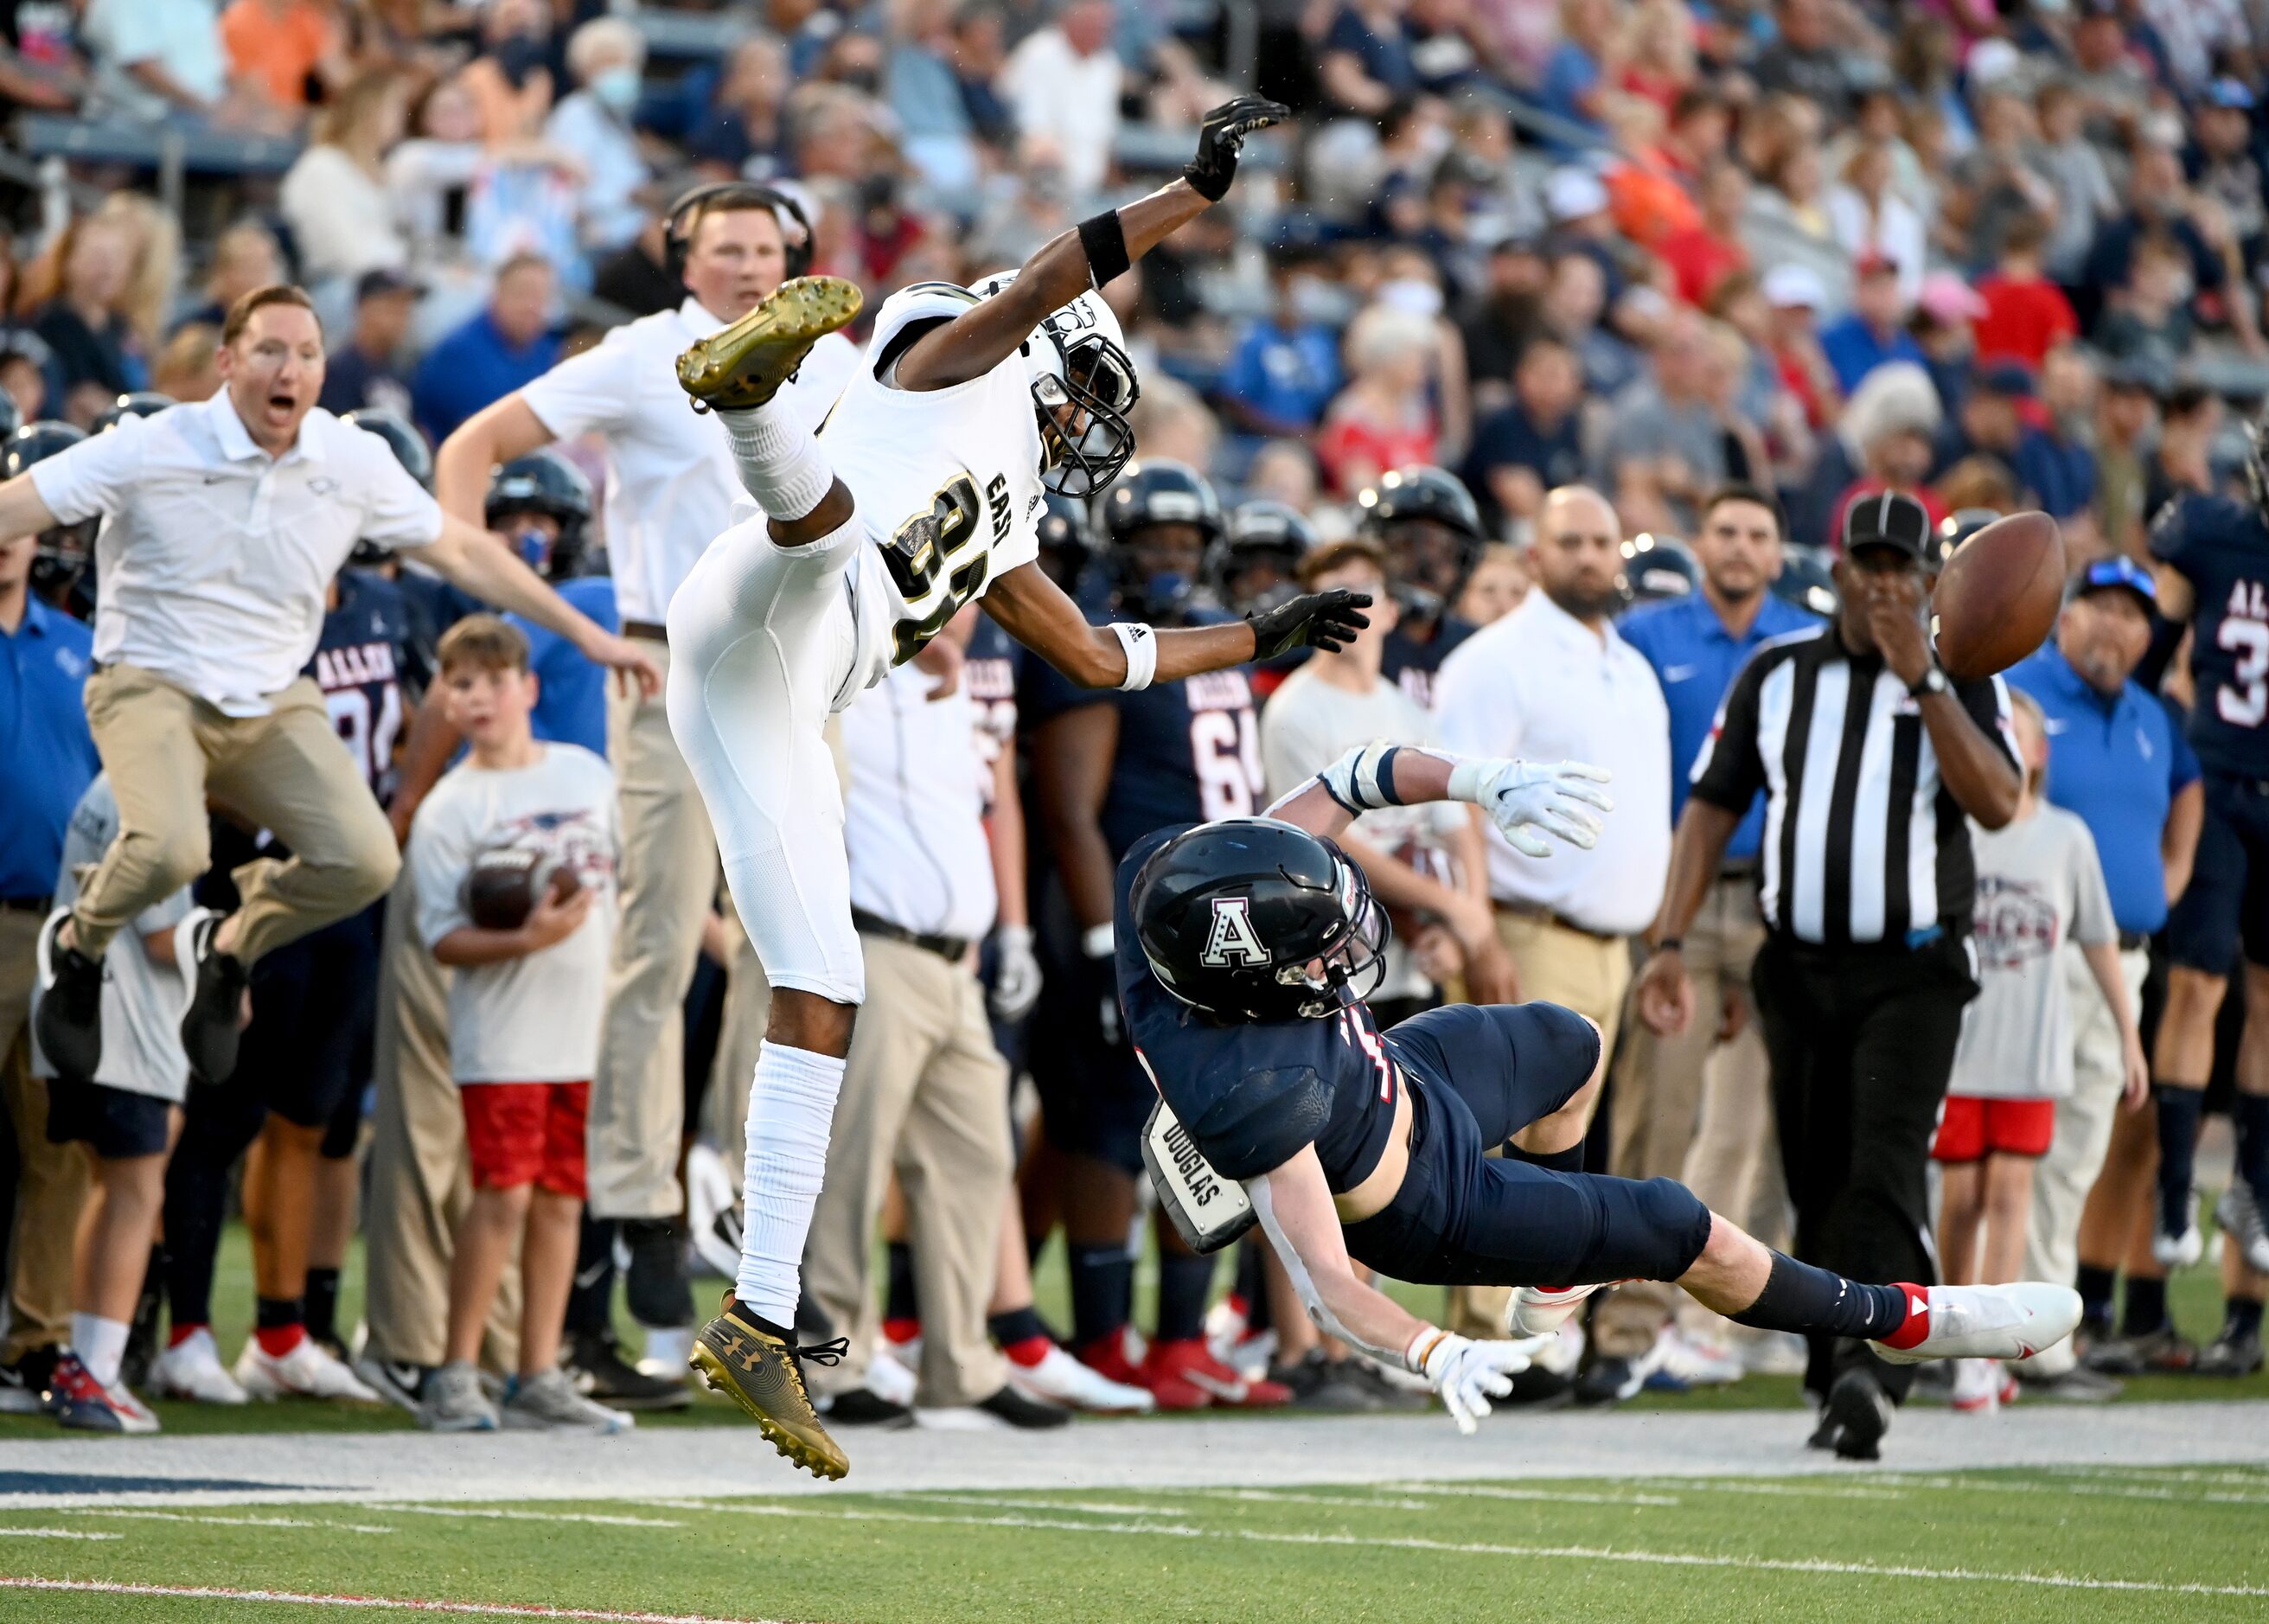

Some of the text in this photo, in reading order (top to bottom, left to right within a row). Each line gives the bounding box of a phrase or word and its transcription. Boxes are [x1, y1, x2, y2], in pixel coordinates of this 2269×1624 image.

[986, 472, 1012, 549] EAST
[1200, 897, 1272, 967] A
[1163, 1123, 1220, 1207] DOUGLAS
